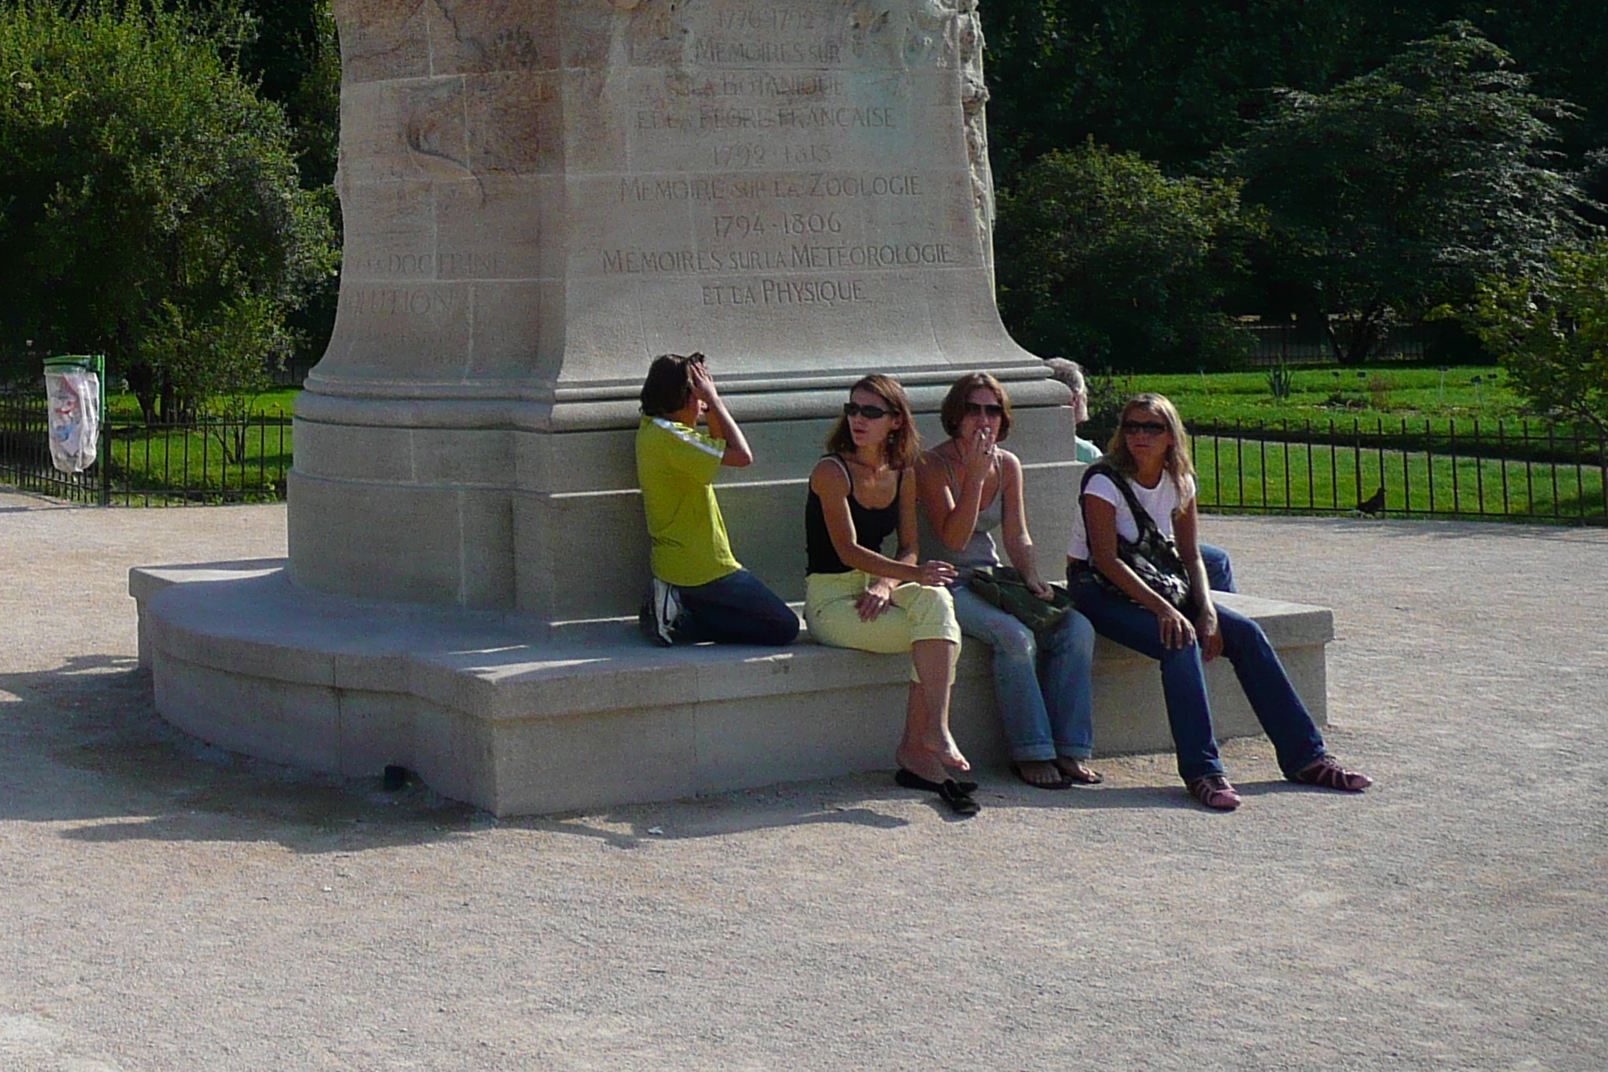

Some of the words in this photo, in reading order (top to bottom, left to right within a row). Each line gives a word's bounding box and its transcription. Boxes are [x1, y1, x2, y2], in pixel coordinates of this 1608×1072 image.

[808, 43, 841, 64] SUR
[809, 172, 924, 196] ZOOLOGIE
[728, 250, 762, 271] SUR
[765, 250, 787, 270] LA
[702, 286, 724, 305] ET
[731, 285, 756, 305] LA
[762, 279, 867, 307] PHYSIQUE
